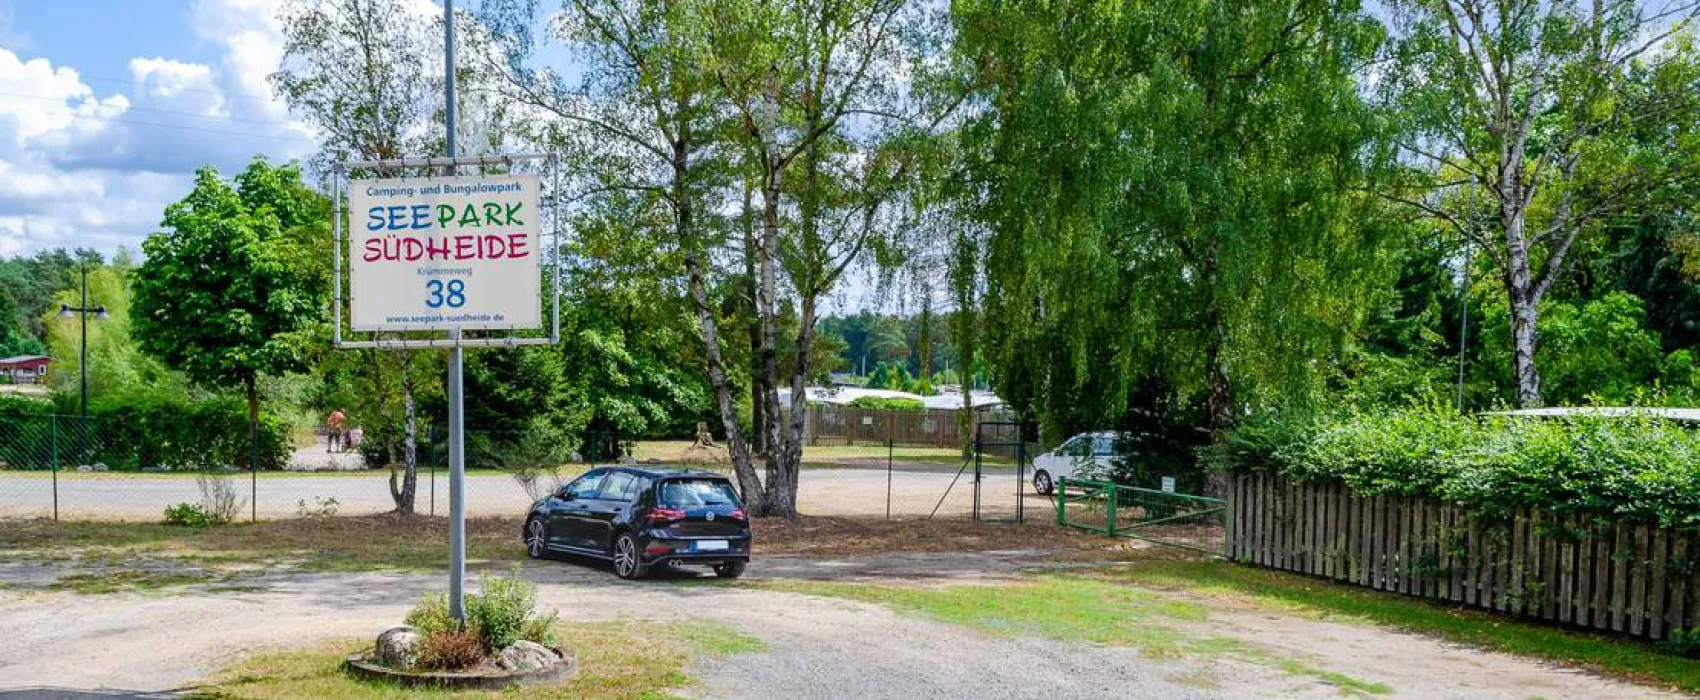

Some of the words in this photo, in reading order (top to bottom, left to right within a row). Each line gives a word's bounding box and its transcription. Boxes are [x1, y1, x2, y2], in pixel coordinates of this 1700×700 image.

[366, 186, 416, 198] Camping-
[420, 184, 441, 195] und
[444, 182, 522, 194] Bungalowpark
[363, 233, 530, 262] SÜDHEIDE
[426, 279, 466, 309] 38
